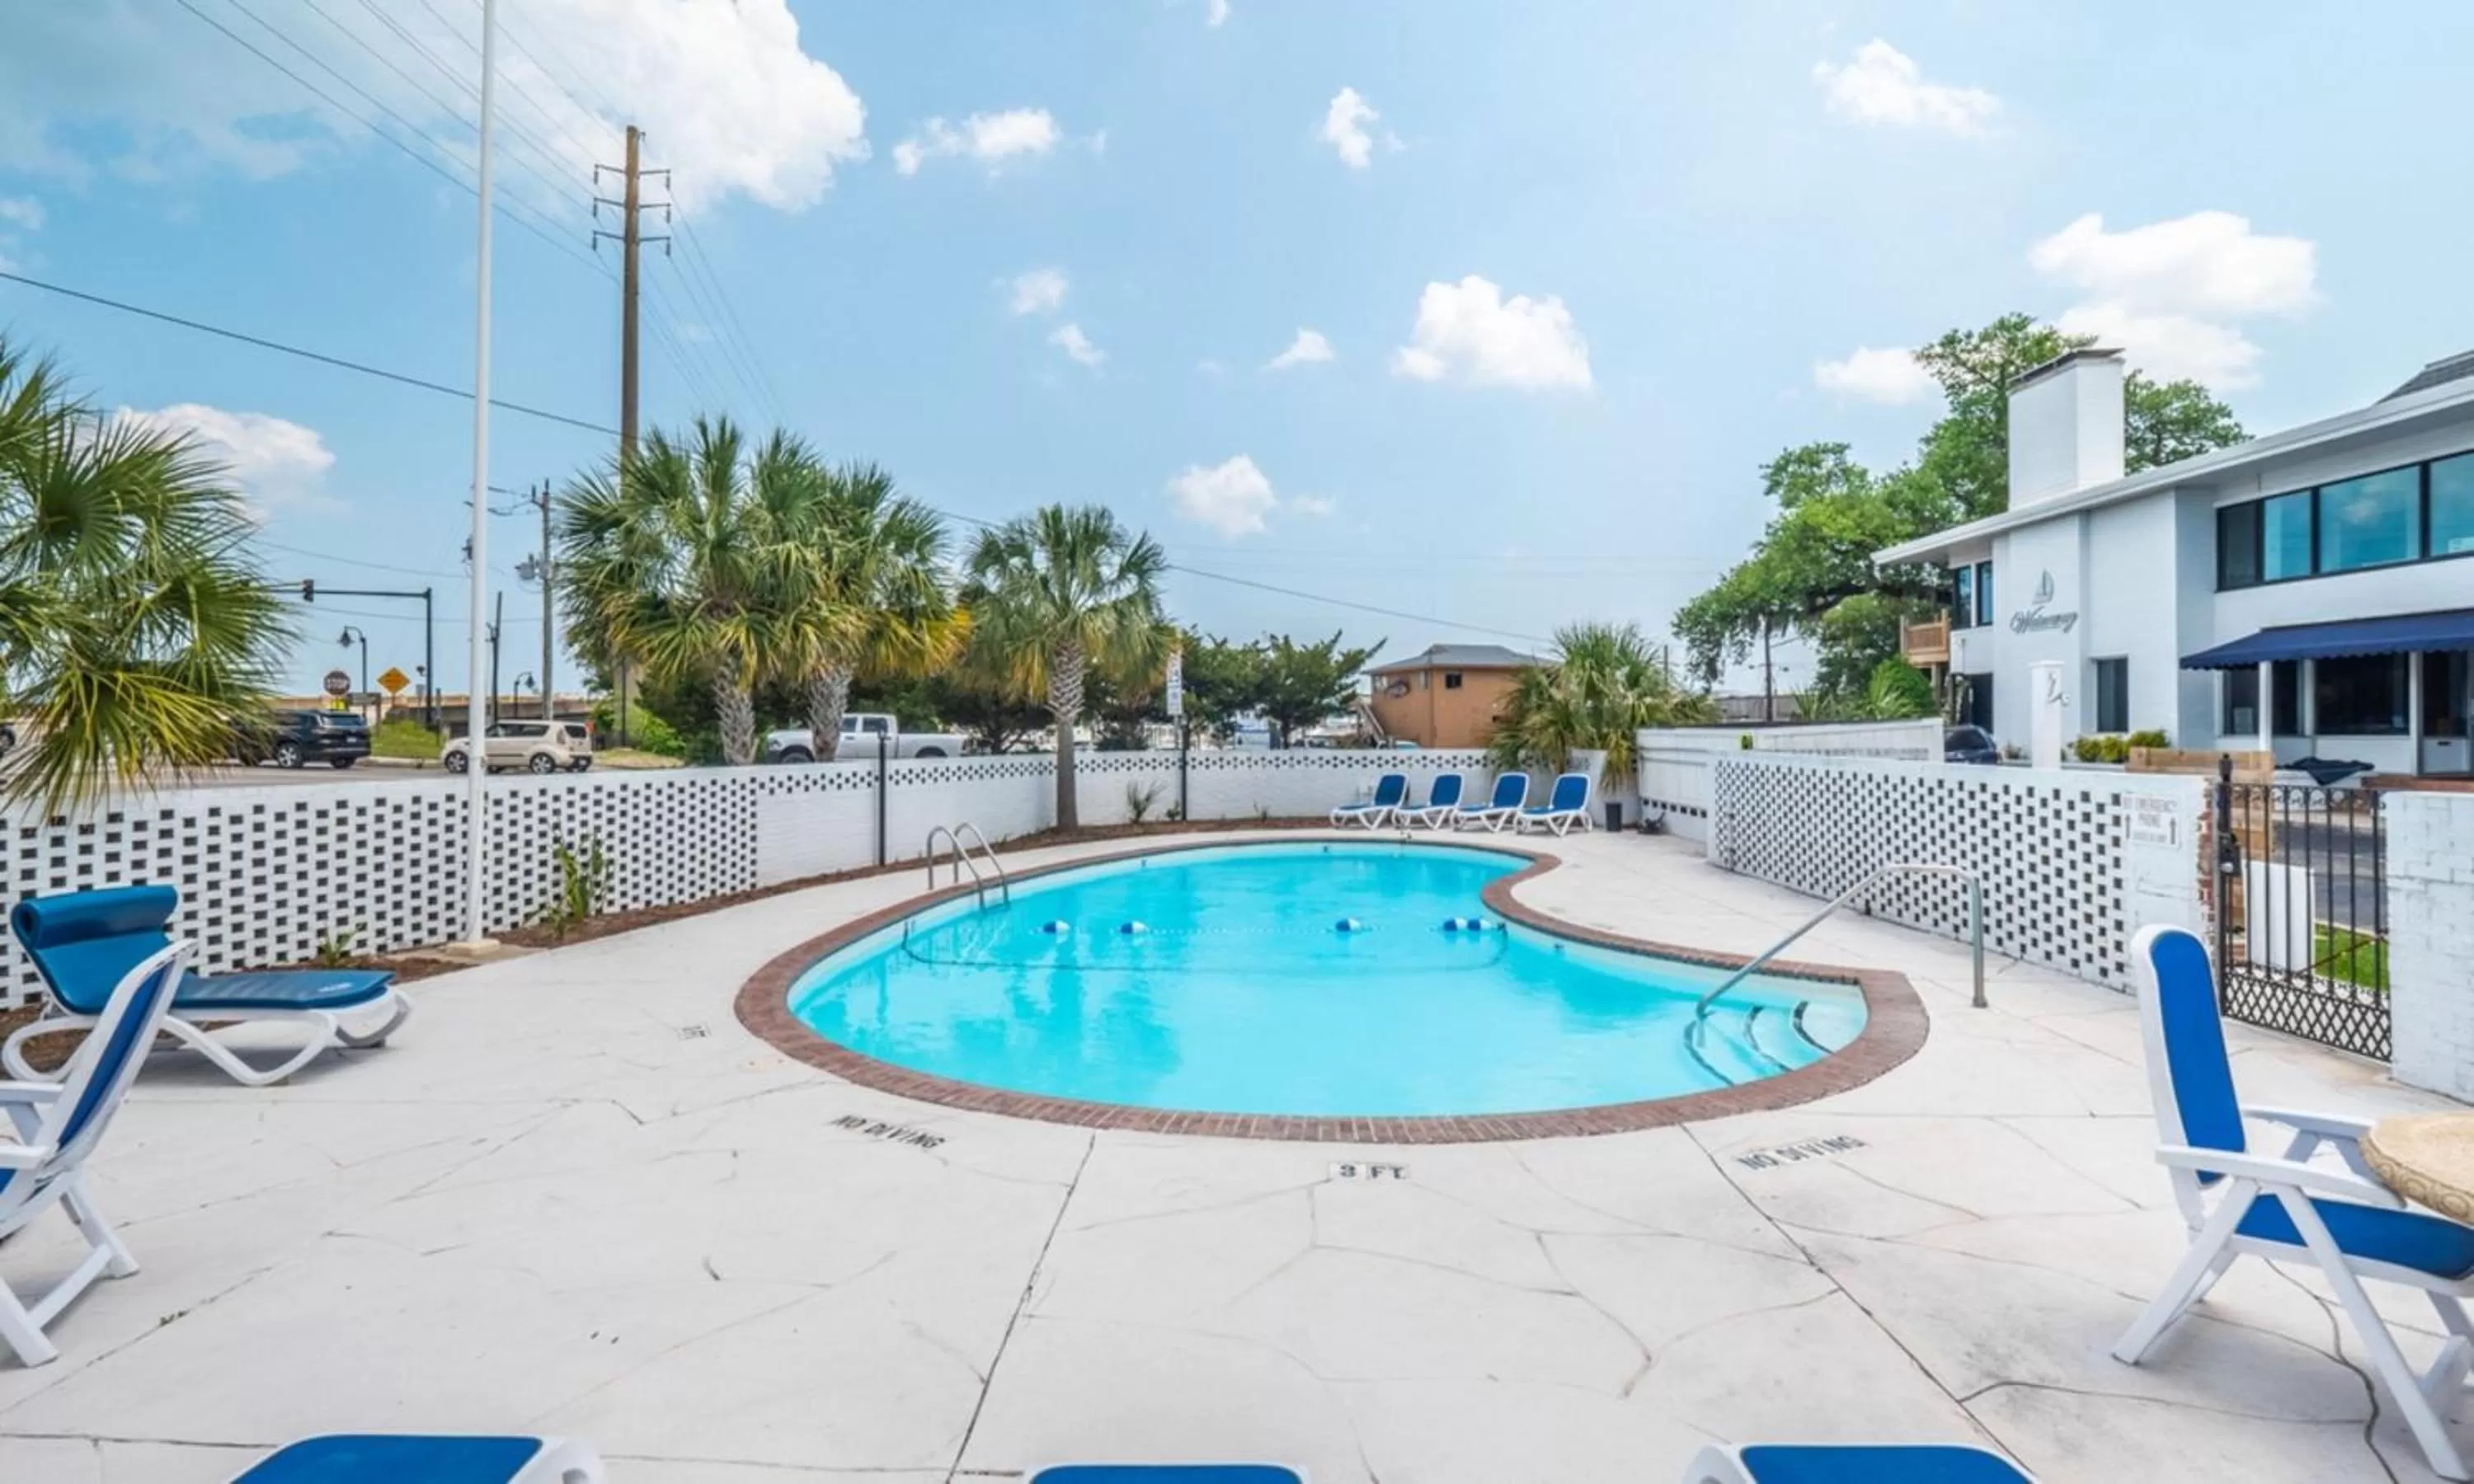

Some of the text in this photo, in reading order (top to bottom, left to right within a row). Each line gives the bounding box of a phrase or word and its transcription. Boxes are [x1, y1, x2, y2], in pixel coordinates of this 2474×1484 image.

[327, 678, 348, 690] STOP
[830, 1115, 946, 1148] NO DIVING
[1736, 1135, 1867, 1170] NO DIVING
[1338, 1164, 1356, 1178] 3
